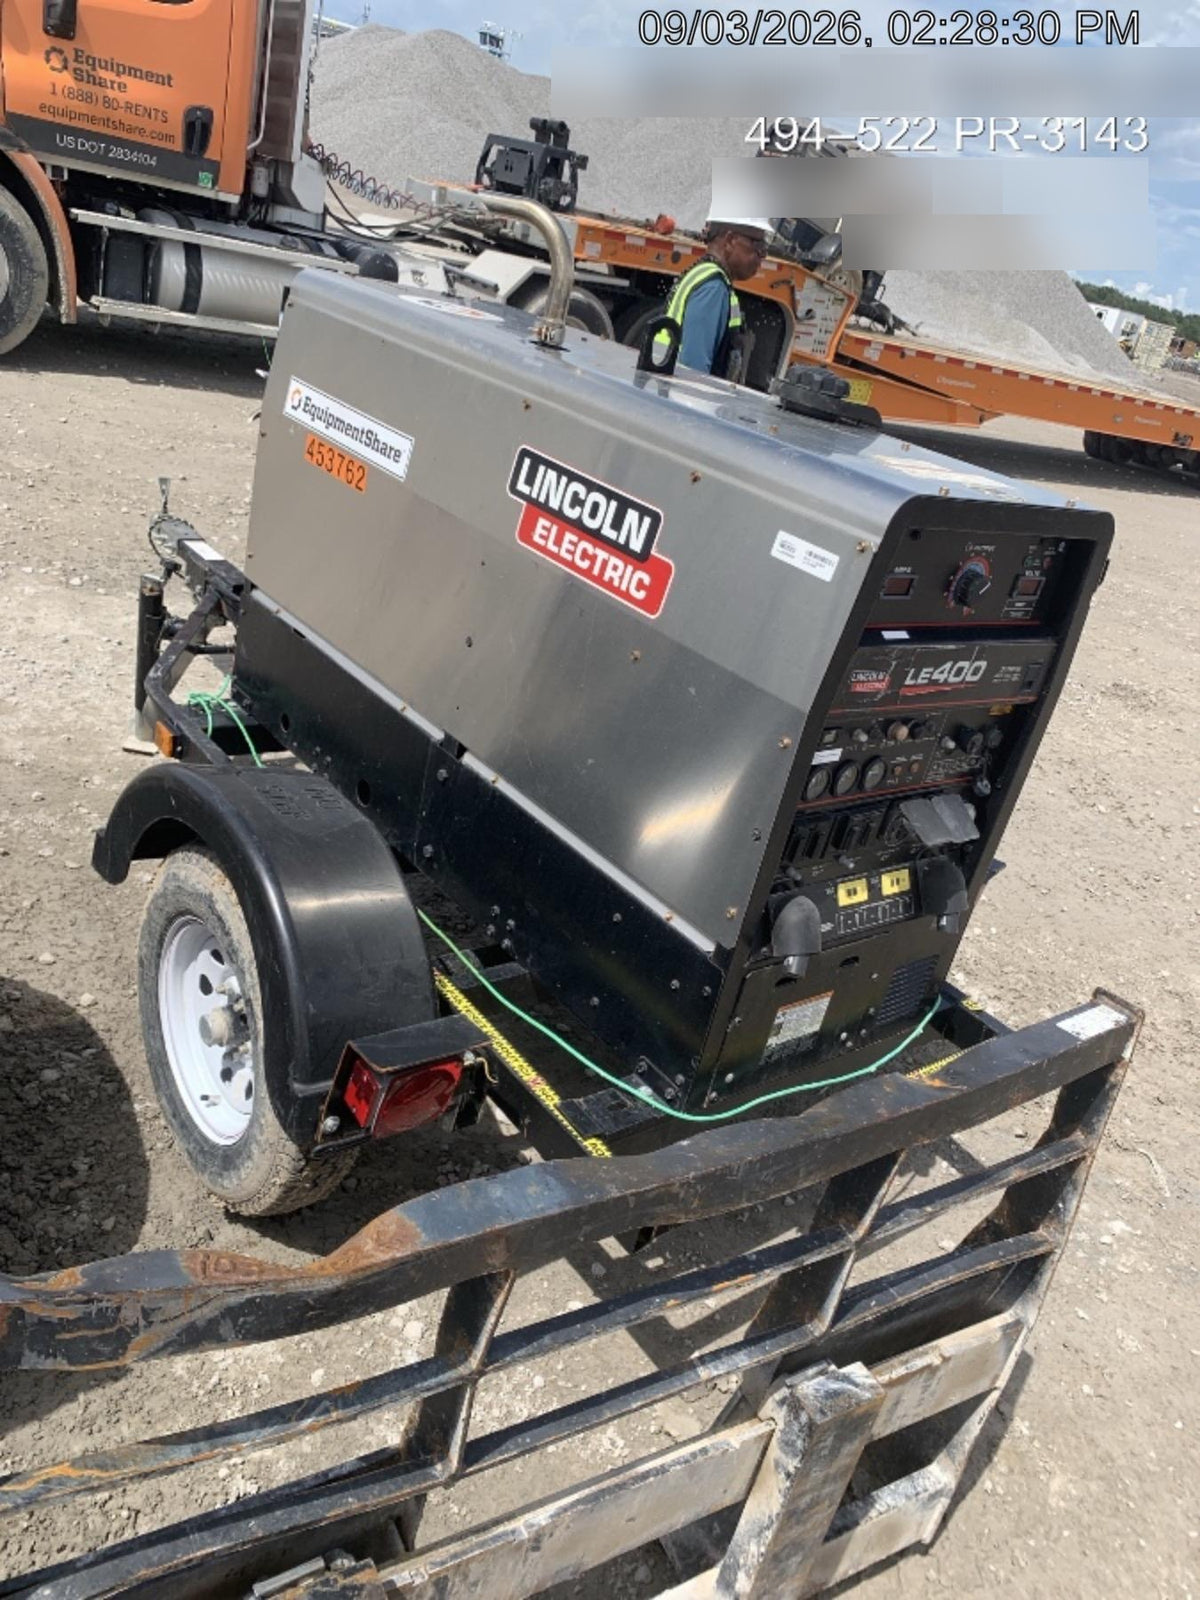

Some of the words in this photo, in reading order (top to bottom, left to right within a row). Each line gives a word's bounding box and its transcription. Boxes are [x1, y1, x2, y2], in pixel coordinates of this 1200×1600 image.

[72, 47, 174, 88] Equipment
[72, 66, 128, 94] Share
[50, 82, 58, 97] 1
[61, 84, 99, 107] (888)
[38, 102, 176, 145] equipmentshare.com
[302, 395, 403, 464] EquipmentShare
[305, 437, 367, 492] 453762
[515, 456, 652, 554] LINCOLN
[532, 517, 651, 601] ELECTRIC
[904, 660, 988, 686] LE400
